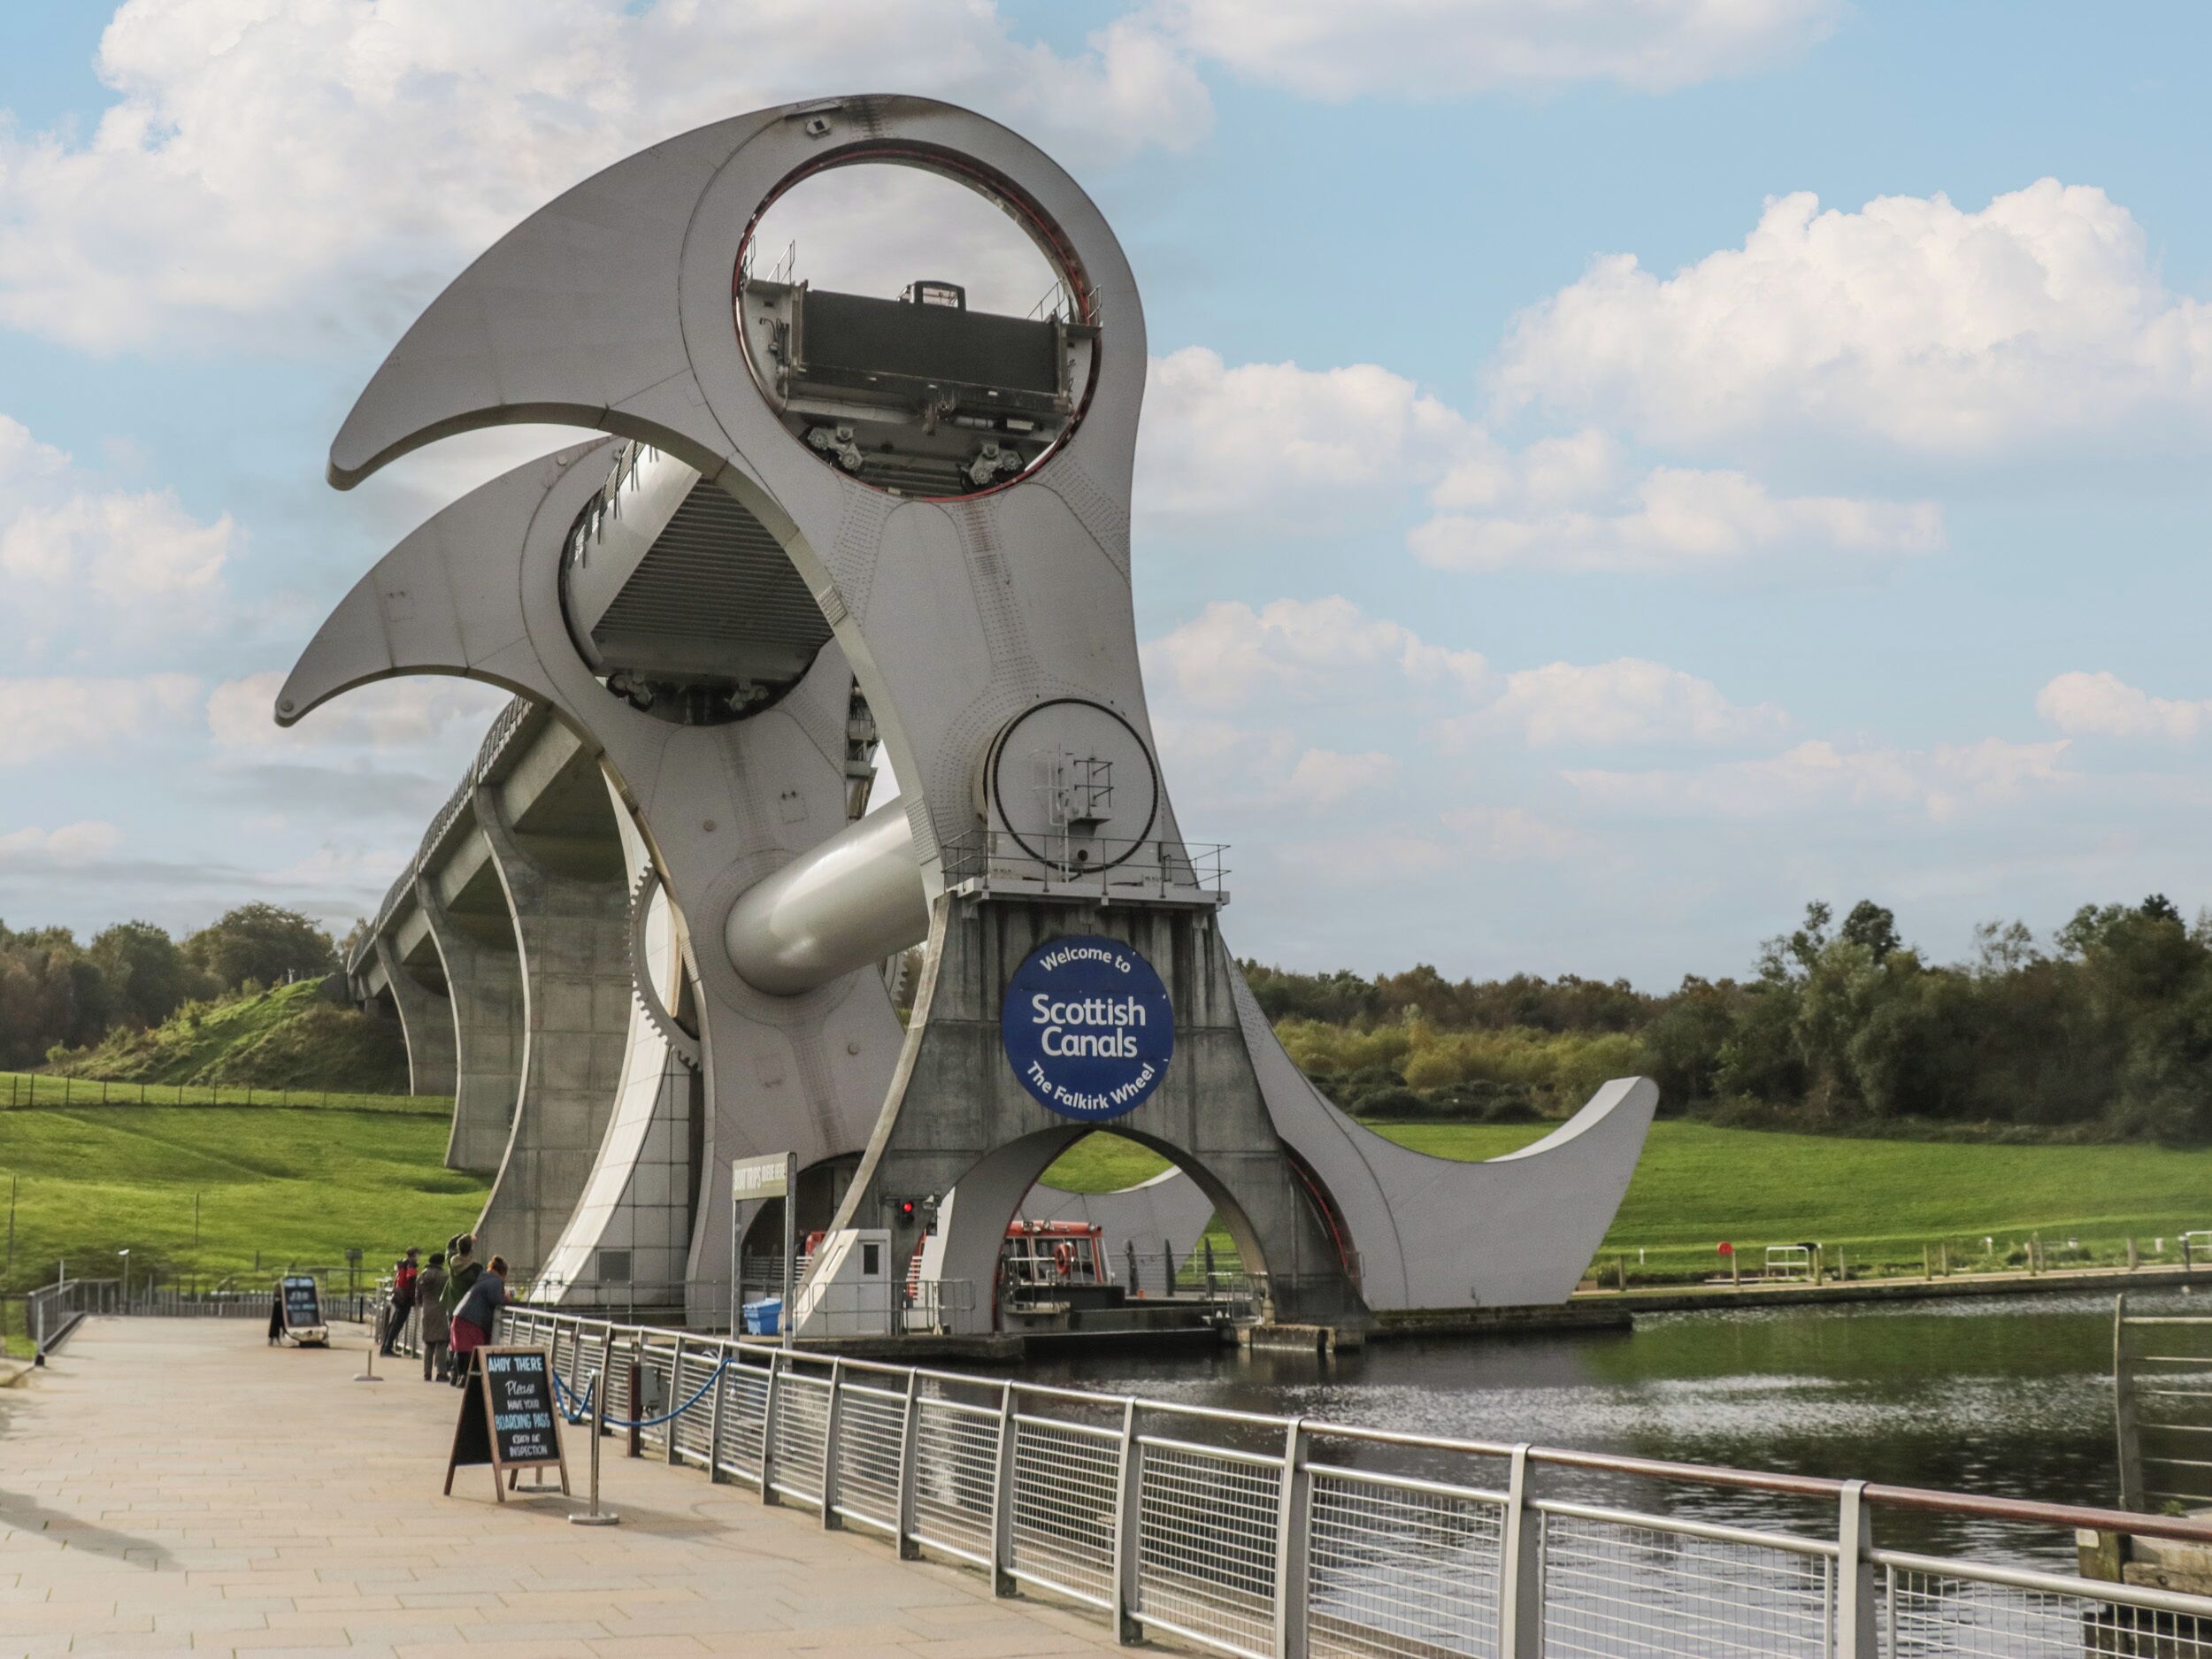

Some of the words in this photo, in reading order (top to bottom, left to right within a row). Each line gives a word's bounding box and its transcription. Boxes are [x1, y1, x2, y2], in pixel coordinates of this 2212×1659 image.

[1040, 947, 1111, 972] Welcome
[1115, 955, 1131, 973] to
[1032, 994, 1146, 1026] Scottish
[1041, 1025, 1138, 1057] Canals
[1026, 1060, 1052, 1094] The
[1054, 1085, 1109, 1110] Falkirk
[1110, 1063, 1156, 1105] Wheel
[488, 1356, 511, 1372] AHOY
[514, 1356, 542, 1372] THERE
[505, 1379, 535, 1395] Please
[524, 1399, 540, 1409] YOUR
[495, 1414, 532, 1431] BOARDING
[533, 1412, 550, 1428] PASS
[510, 1446, 548, 1458] INSPECTION
